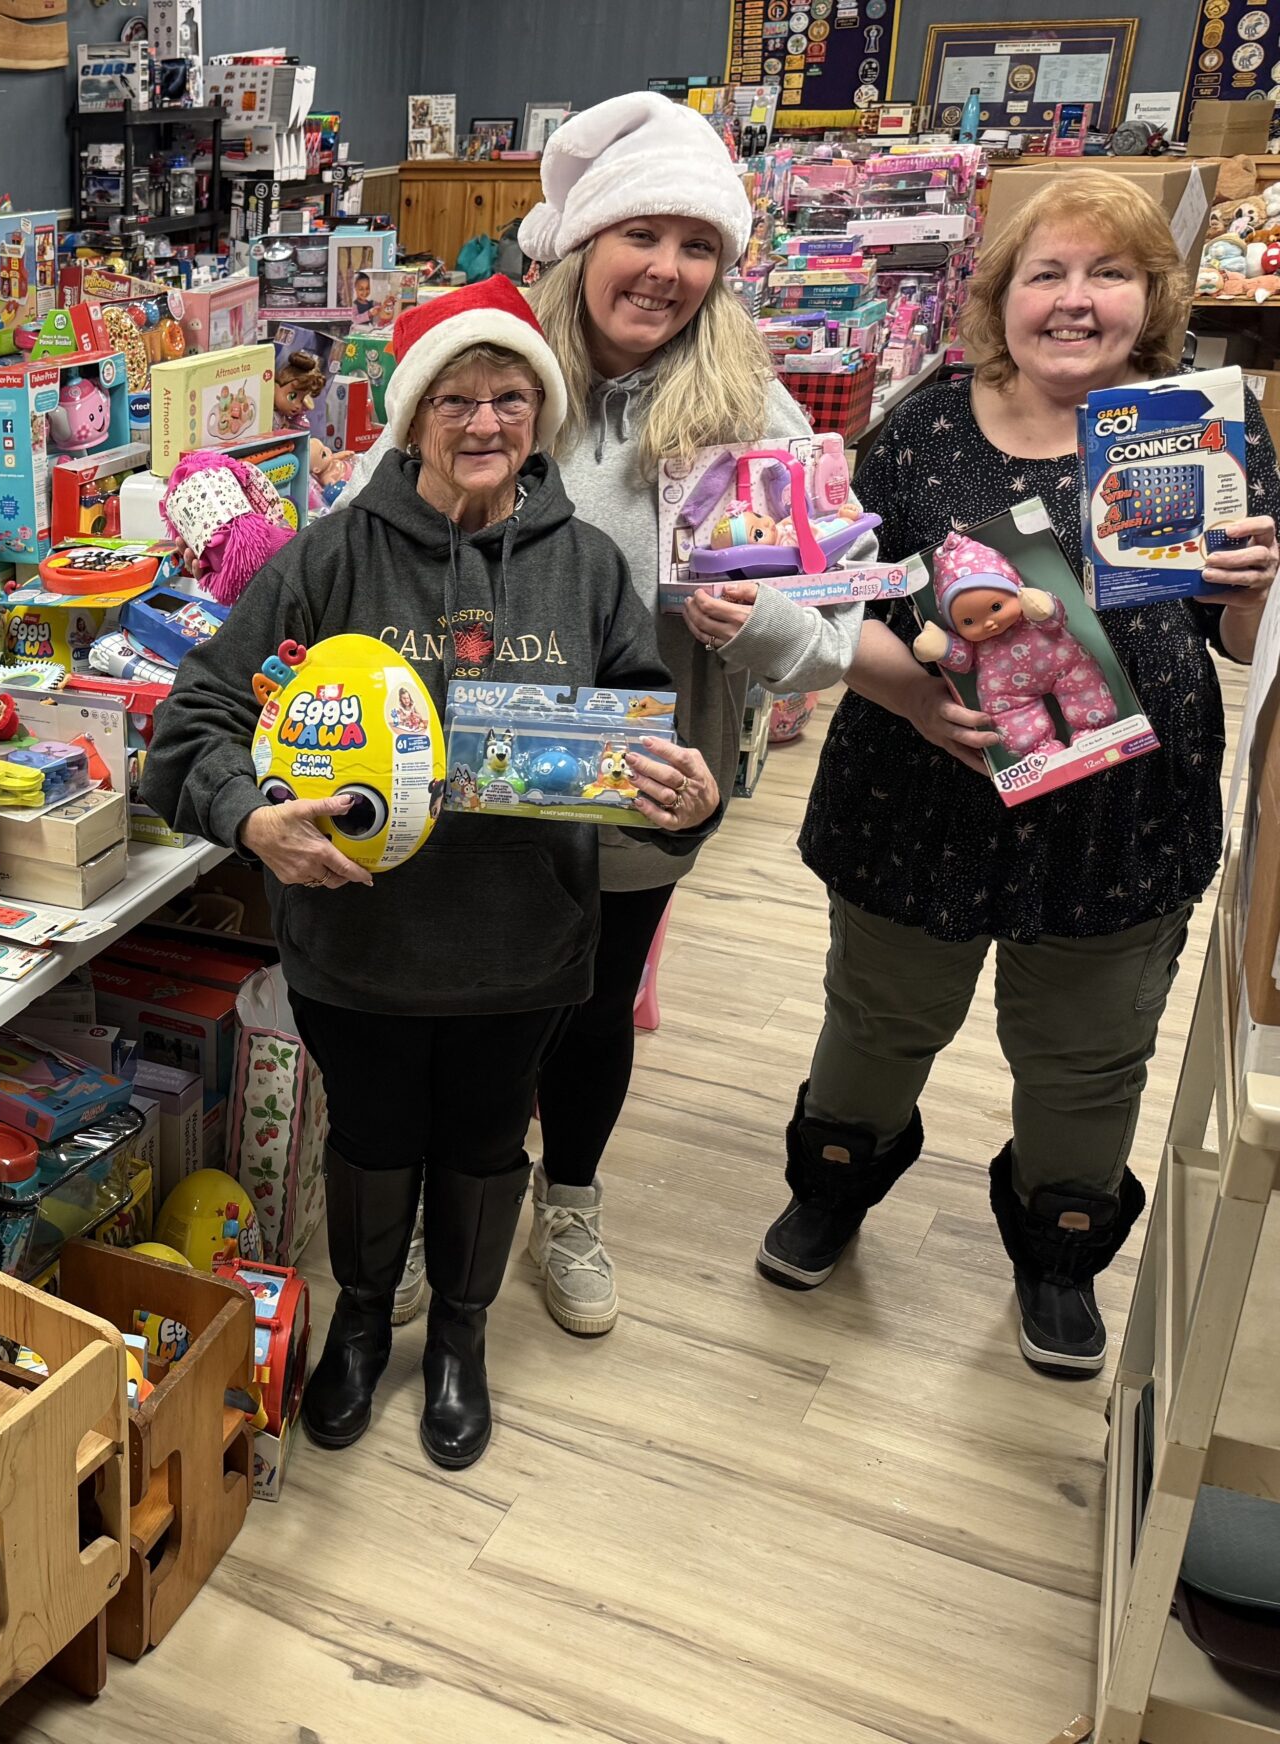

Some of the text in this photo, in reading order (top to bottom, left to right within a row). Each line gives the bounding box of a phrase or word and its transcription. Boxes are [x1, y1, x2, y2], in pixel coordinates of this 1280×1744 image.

[81, 63, 136, 76] CHASE
[1134, 103, 1170, 114] Proclamation
[31, 371, 57, 384] Fisher-Price
[215, 363, 251, 379] Aftrnoon tea
[163, 388, 172, 457] Aftrnoon tea
[1095, 413, 1139, 437] GO!
[1108, 421, 1224, 463] CONNECT 4
[1105, 473, 1120, 490] 4
[1106, 506, 1121, 522] 4
[784, 585, 847, 600] Tote Along Baby
[852, 585, 859, 596] 8
[437, 609, 494, 629] WESTPO
[380, 626, 568, 665] CANADA
[454, 685, 507, 707] BLUEY
[288, 692, 360, 727] Eggy
[280, 718, 364, 747] WAWA
[396, 739, 407, 750] 61
[296, 753, 331, 764] LEARN
[291, 763, 335, 779] SCHOOL
[996, 761, 1030, 790] you
[1012, 770, 1040, 789] me
[161, 1319, 189, 1341] Eg
